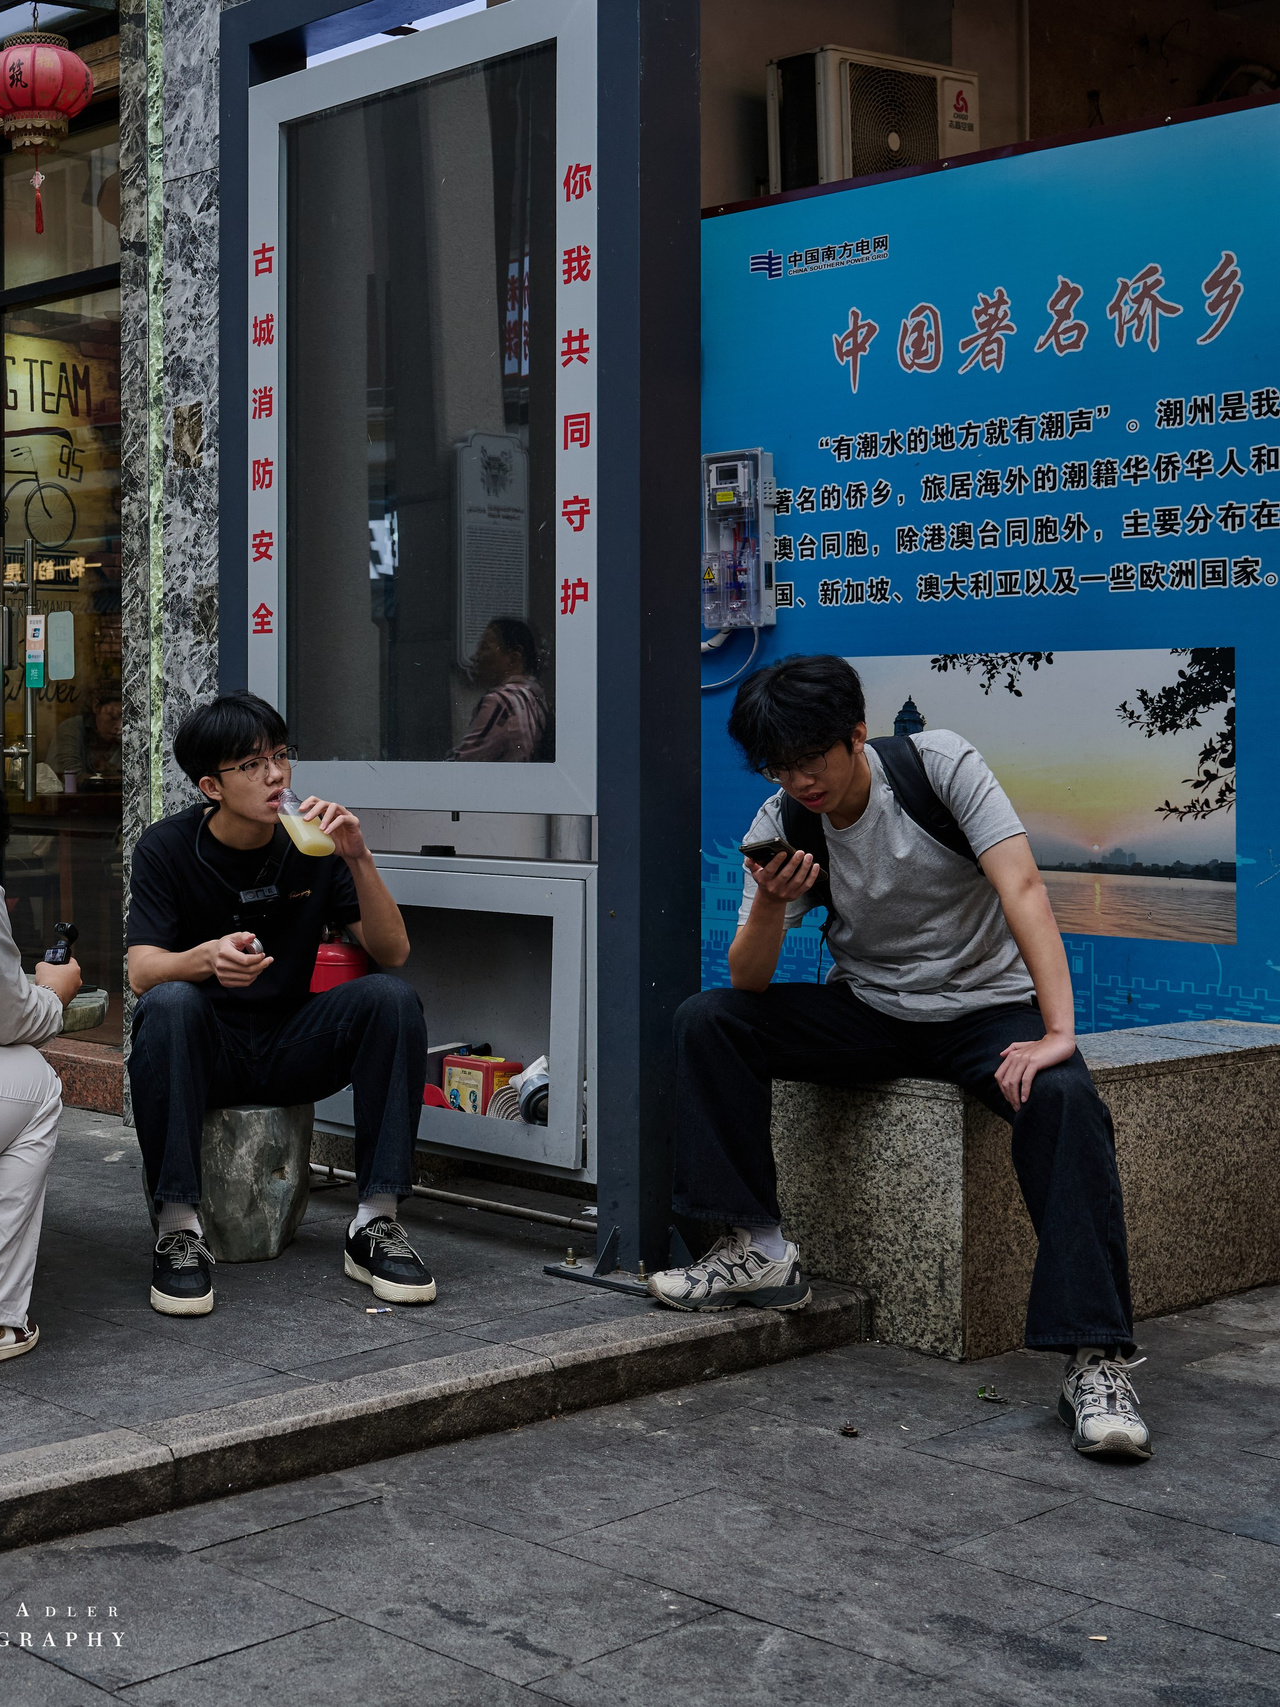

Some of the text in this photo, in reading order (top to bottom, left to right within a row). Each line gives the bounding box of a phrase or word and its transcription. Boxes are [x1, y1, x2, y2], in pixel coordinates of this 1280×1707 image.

[787, 234, 889, 268] 中国南方电网
[788, 252, 889, 276] CHINA SOUTHERN POWER GRID
[833, 250, 1244, 393] 中国著名侨乡
[23, 357, 92, 418] TEAM
[561, 162, 592, 615] 你我共同守护
[58, 444, 86, 483] 95
[252, 242, 275, 635] 古城消防安全
